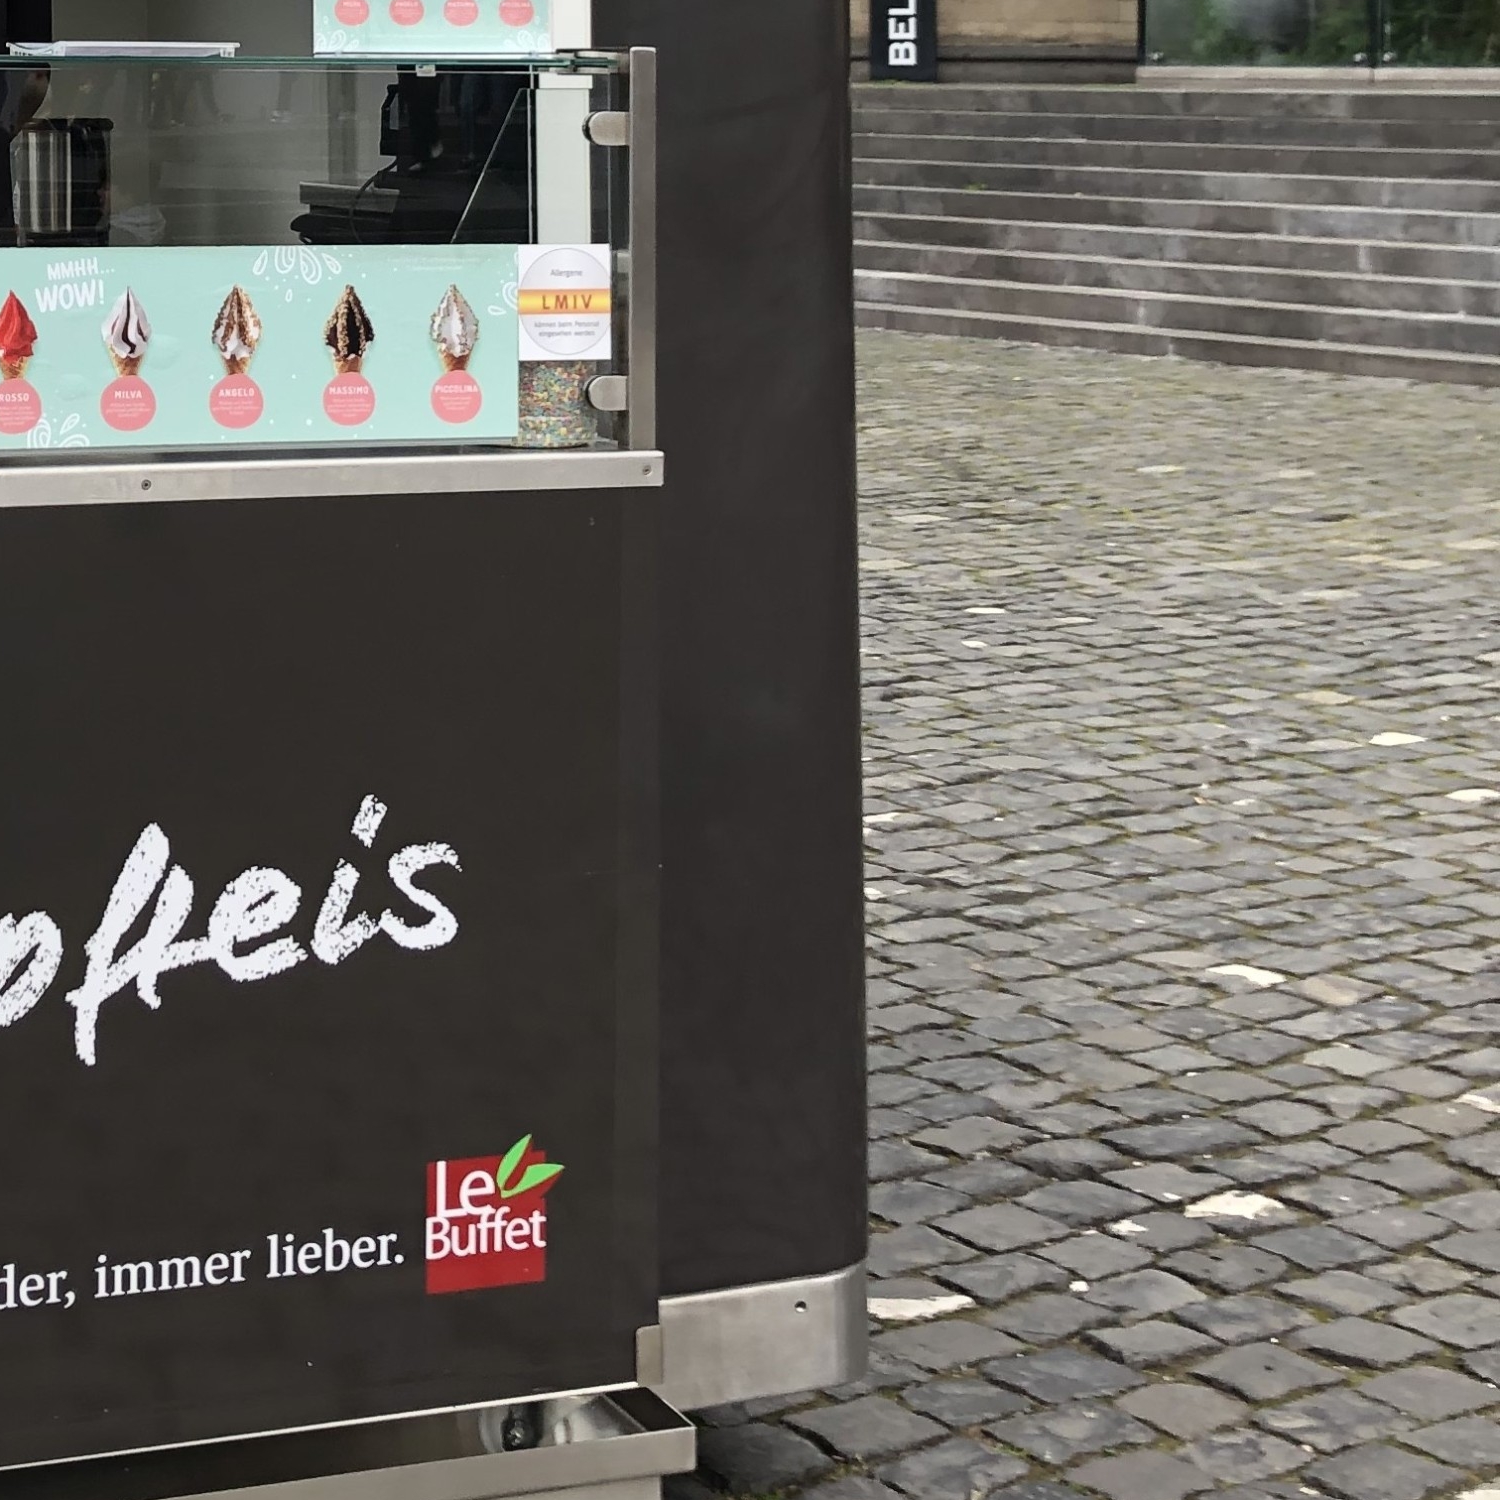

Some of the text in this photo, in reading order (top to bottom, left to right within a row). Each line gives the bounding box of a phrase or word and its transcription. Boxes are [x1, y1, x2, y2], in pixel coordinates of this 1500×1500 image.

[34, 278, 105, 313] WOW!
[114, 389, 143, 399] MILVA
[436, 1160, 496, 1218] Le
[425, 1206, 547, 1260] Buffet
[93, 1244, 252, 1299] immer
[266, 1227, 405, 1280] lieber.
